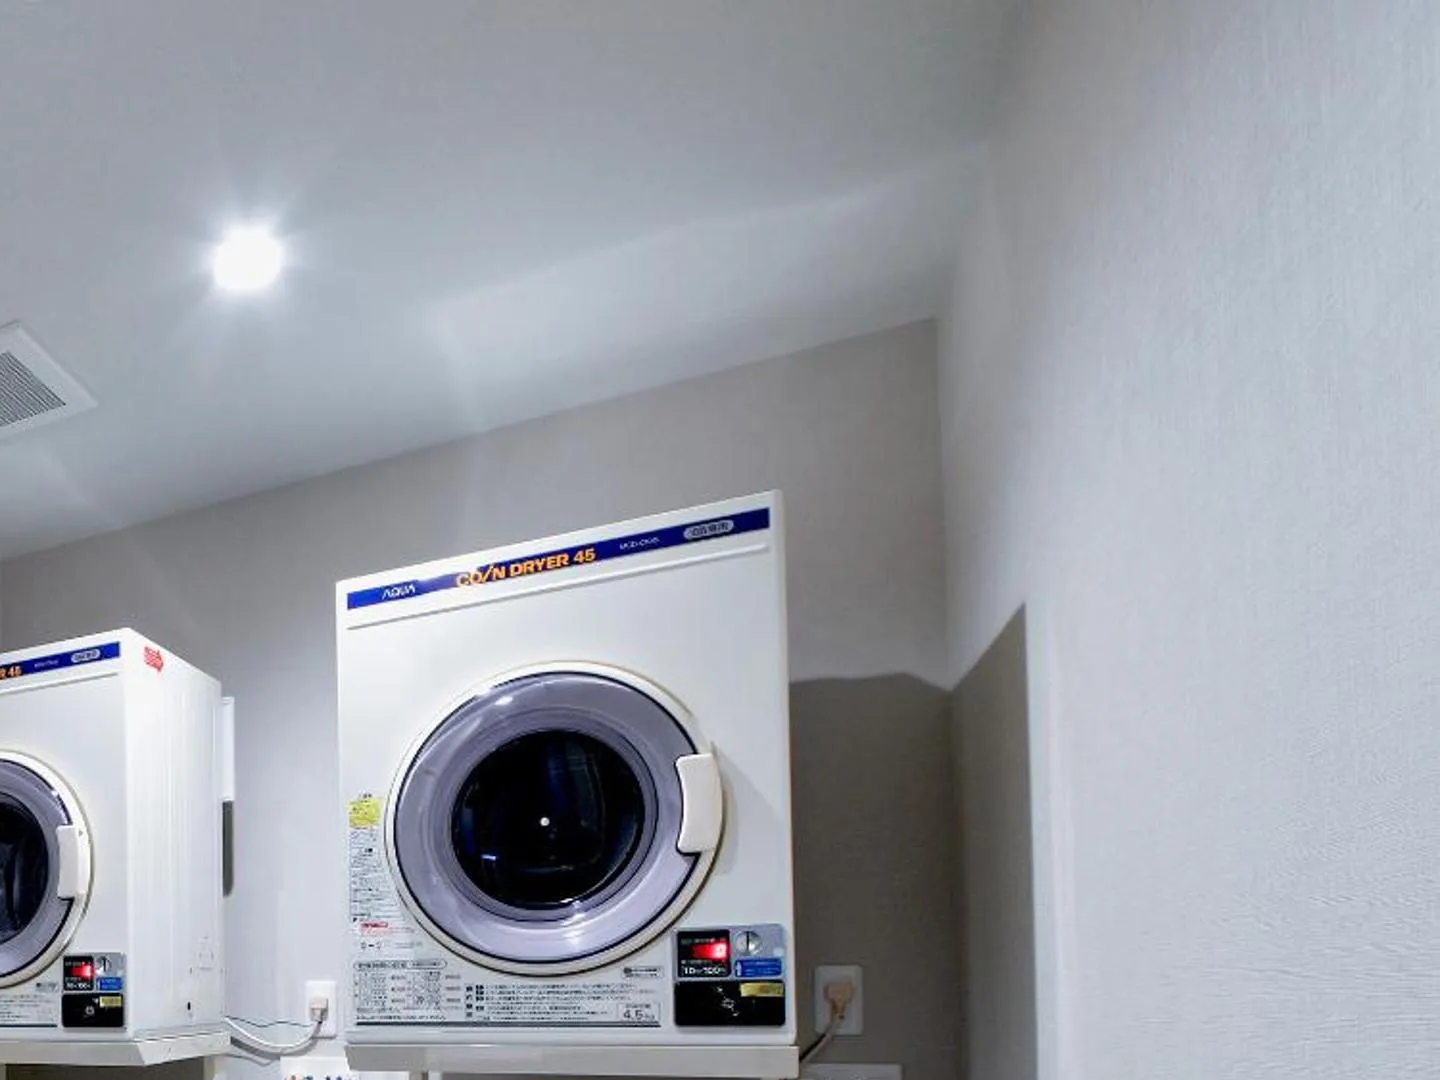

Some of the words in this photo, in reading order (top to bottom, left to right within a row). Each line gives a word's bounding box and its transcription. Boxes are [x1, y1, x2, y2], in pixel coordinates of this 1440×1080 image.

[382, 584, 416, 599] AQUA
[456, 562, 506, 588] COIN
[510, 553, 570, 577] DRYER
[573, 548, 595, 565] 45
